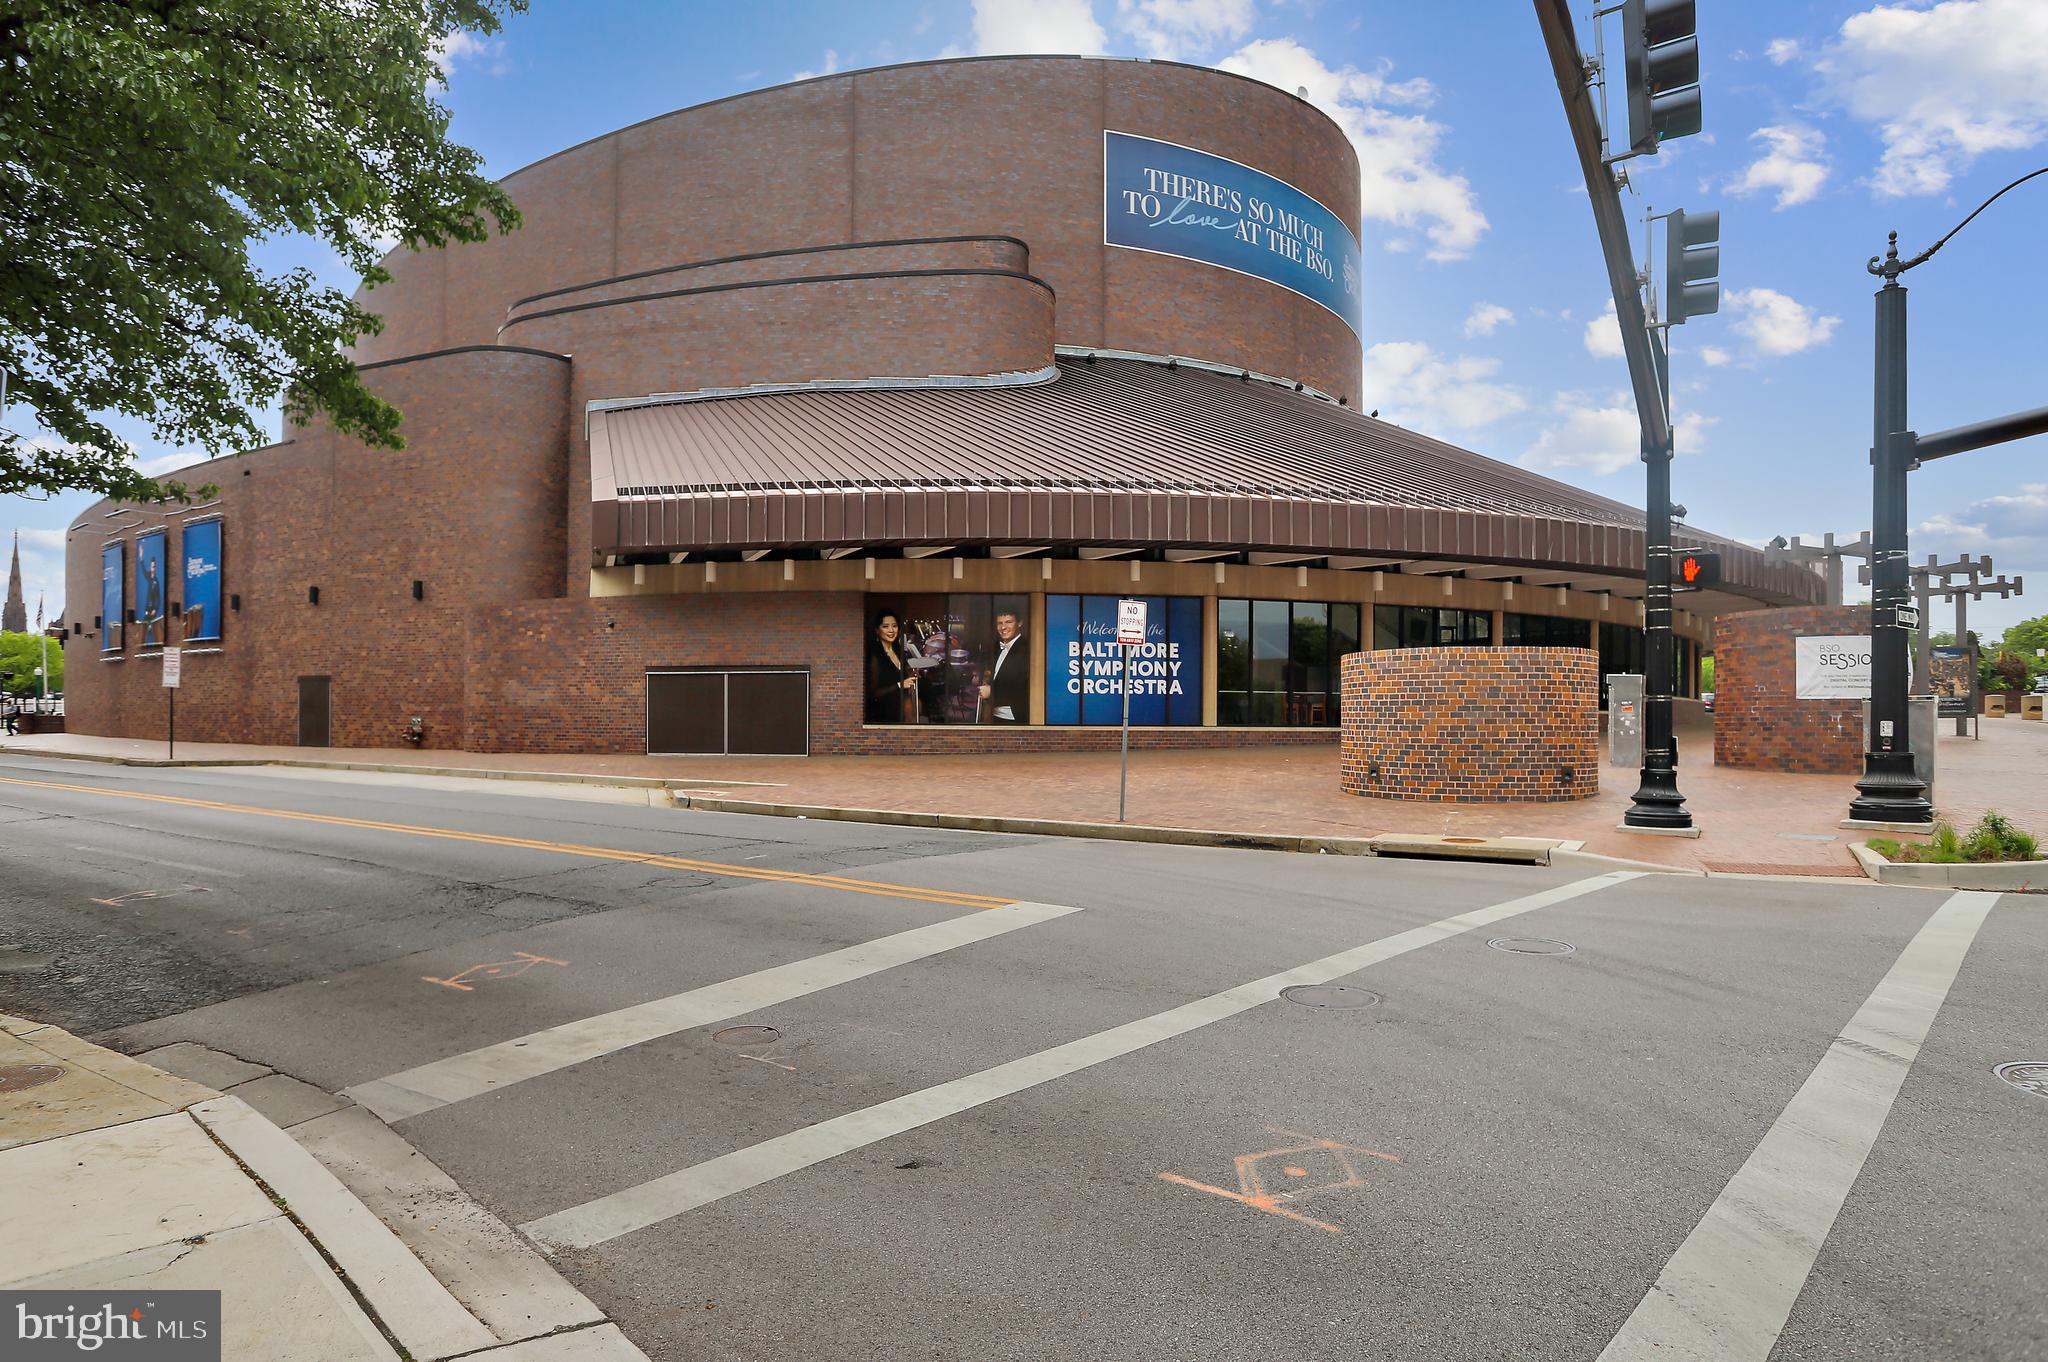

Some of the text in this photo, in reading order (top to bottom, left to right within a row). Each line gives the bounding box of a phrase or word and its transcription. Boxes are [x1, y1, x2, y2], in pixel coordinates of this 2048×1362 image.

[1144, 167, 1323, 250] THERE'S SO MUCH
[1122, 190, 1161, 218] TO
[1149, 196, 1238, 230] love
[1234, 218, 1262, 245] AT
[1266, 227, 1302, 264] THE
[1305, 247, 1334, 283] BSO.
[1127, 606, 1138, 615] NO
[1077, 620, 1166, 637] Welco the
[1120, 617, 1144, 627] STOPPING
[1068, 641, 1179, 658] BALTIMORE
[1819, 644, 1841, 653] BSO
[1068, 659, 1182, 677] SYMPHONY
[1819, 653, 1872, 670] SESSIO
[1067, 678, 1183, 695] ORCHESTRA
